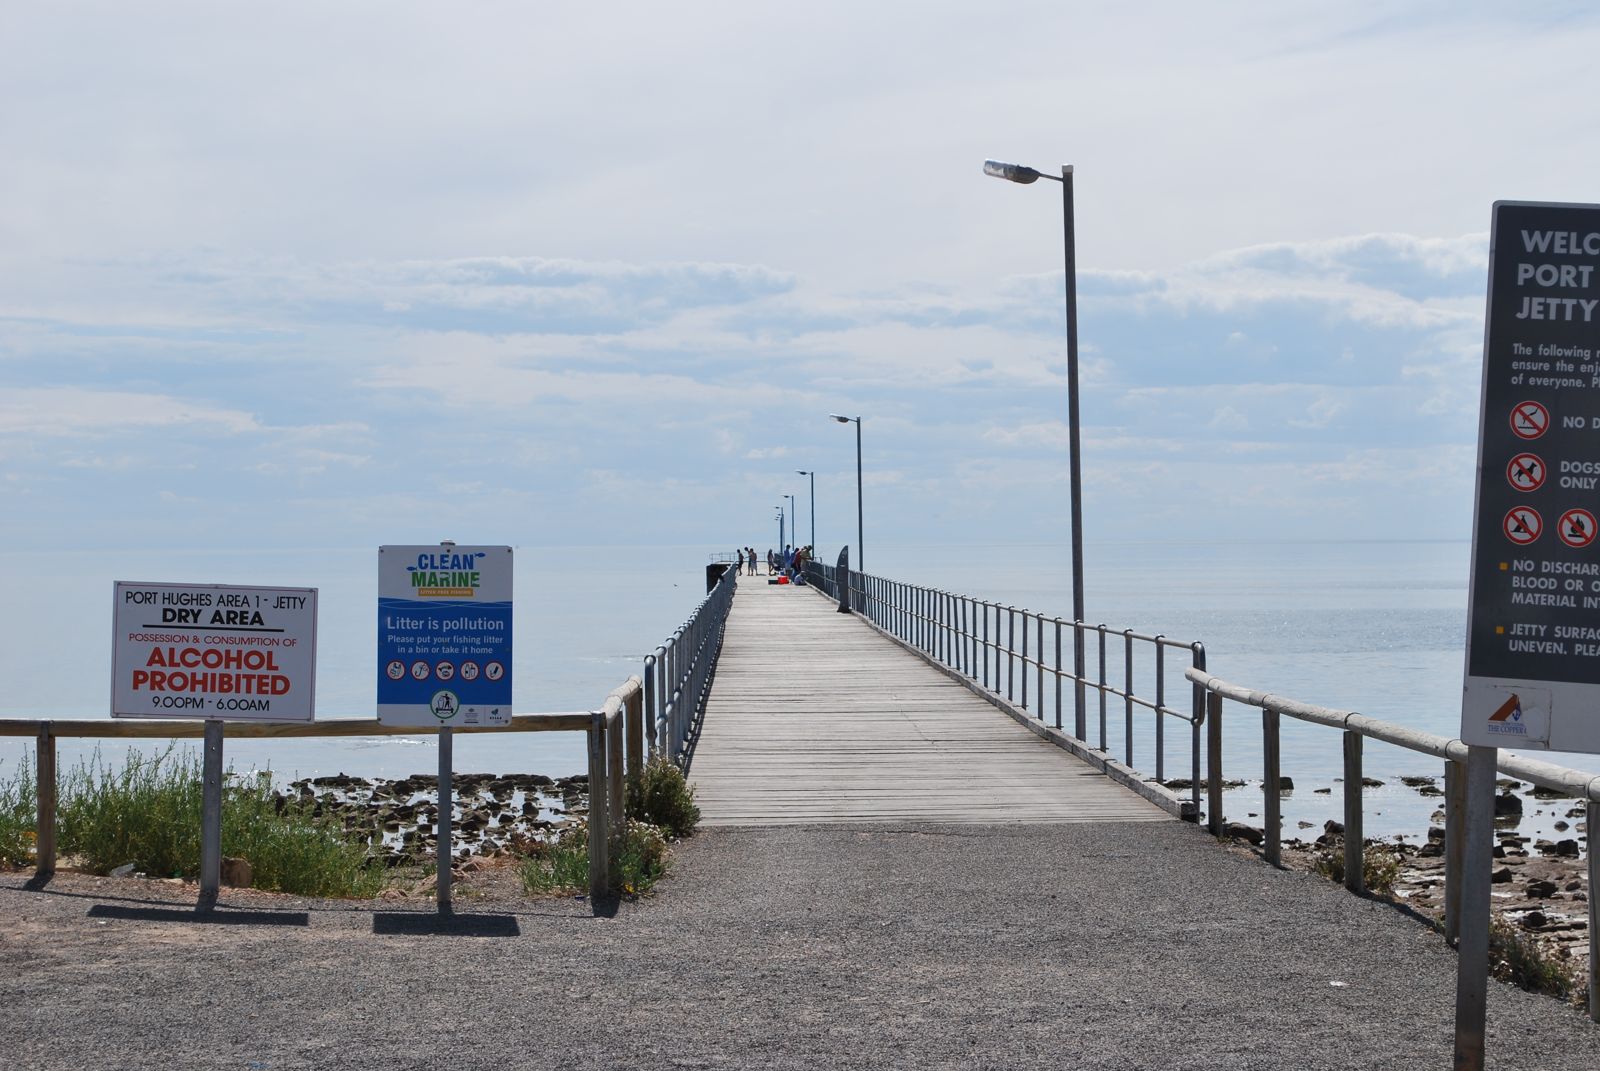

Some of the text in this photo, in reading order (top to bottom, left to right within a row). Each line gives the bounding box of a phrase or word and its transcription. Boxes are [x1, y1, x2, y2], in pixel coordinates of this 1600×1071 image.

[1521, 230, 1600, 255] WELC
[1517, 263, 1594, 288] PORT
[1515, 297, 1599, 321] JETTY
[1513, 343, 1532, 355] The
[1538, 344, 1590, 360] following
[1512, 360, 1600, 376] ensure the enj
[1511, 373, 1523, 385] of
[1529, 376, 1585, 389] everyone.
[1563, 416, 1585, 428] NO
[1560, 461, 1600, 474] DOGS
[1560, 476, 1598, 489] ONLY
[418, 554, 474, 570] CLEAN
[1513, 560, 1600, 575] NO DISCHAR
[411, 572, 480, 587] MARINE
[1512, 576, 1557, 589] BLOOD
[1565, 579, 1584, 591] OR
[125, 591, 158, 605] PORT
[162, 593, 212, 607] HUGHES
[216, 594, 250, 608] AREA
[255, 595, 260, 608] 1
[273, 596, 306, 610] JETTY
[1512, 592, 1600, 608] MATERIAL IN
[162, 608, 265, 626] DRY AREA
[387, 617, 503, 632] Litter is pollution
[1510, 624, 1547, 636] JETTY
[128, 633, 297, 647] POSSESSION & CONSUMPTION OF
[388, 635, 503, 645] Please put your fishing litter
[1509, 640, 1567, 654] UNEVEN.
[146, 647, 279, 671] ALCOHOL
[132, 670, 290, 695] PROHIBITED
[152, 696, 204, 709] 9.00PM
[216, 698, 270, 711] 6.00AM
